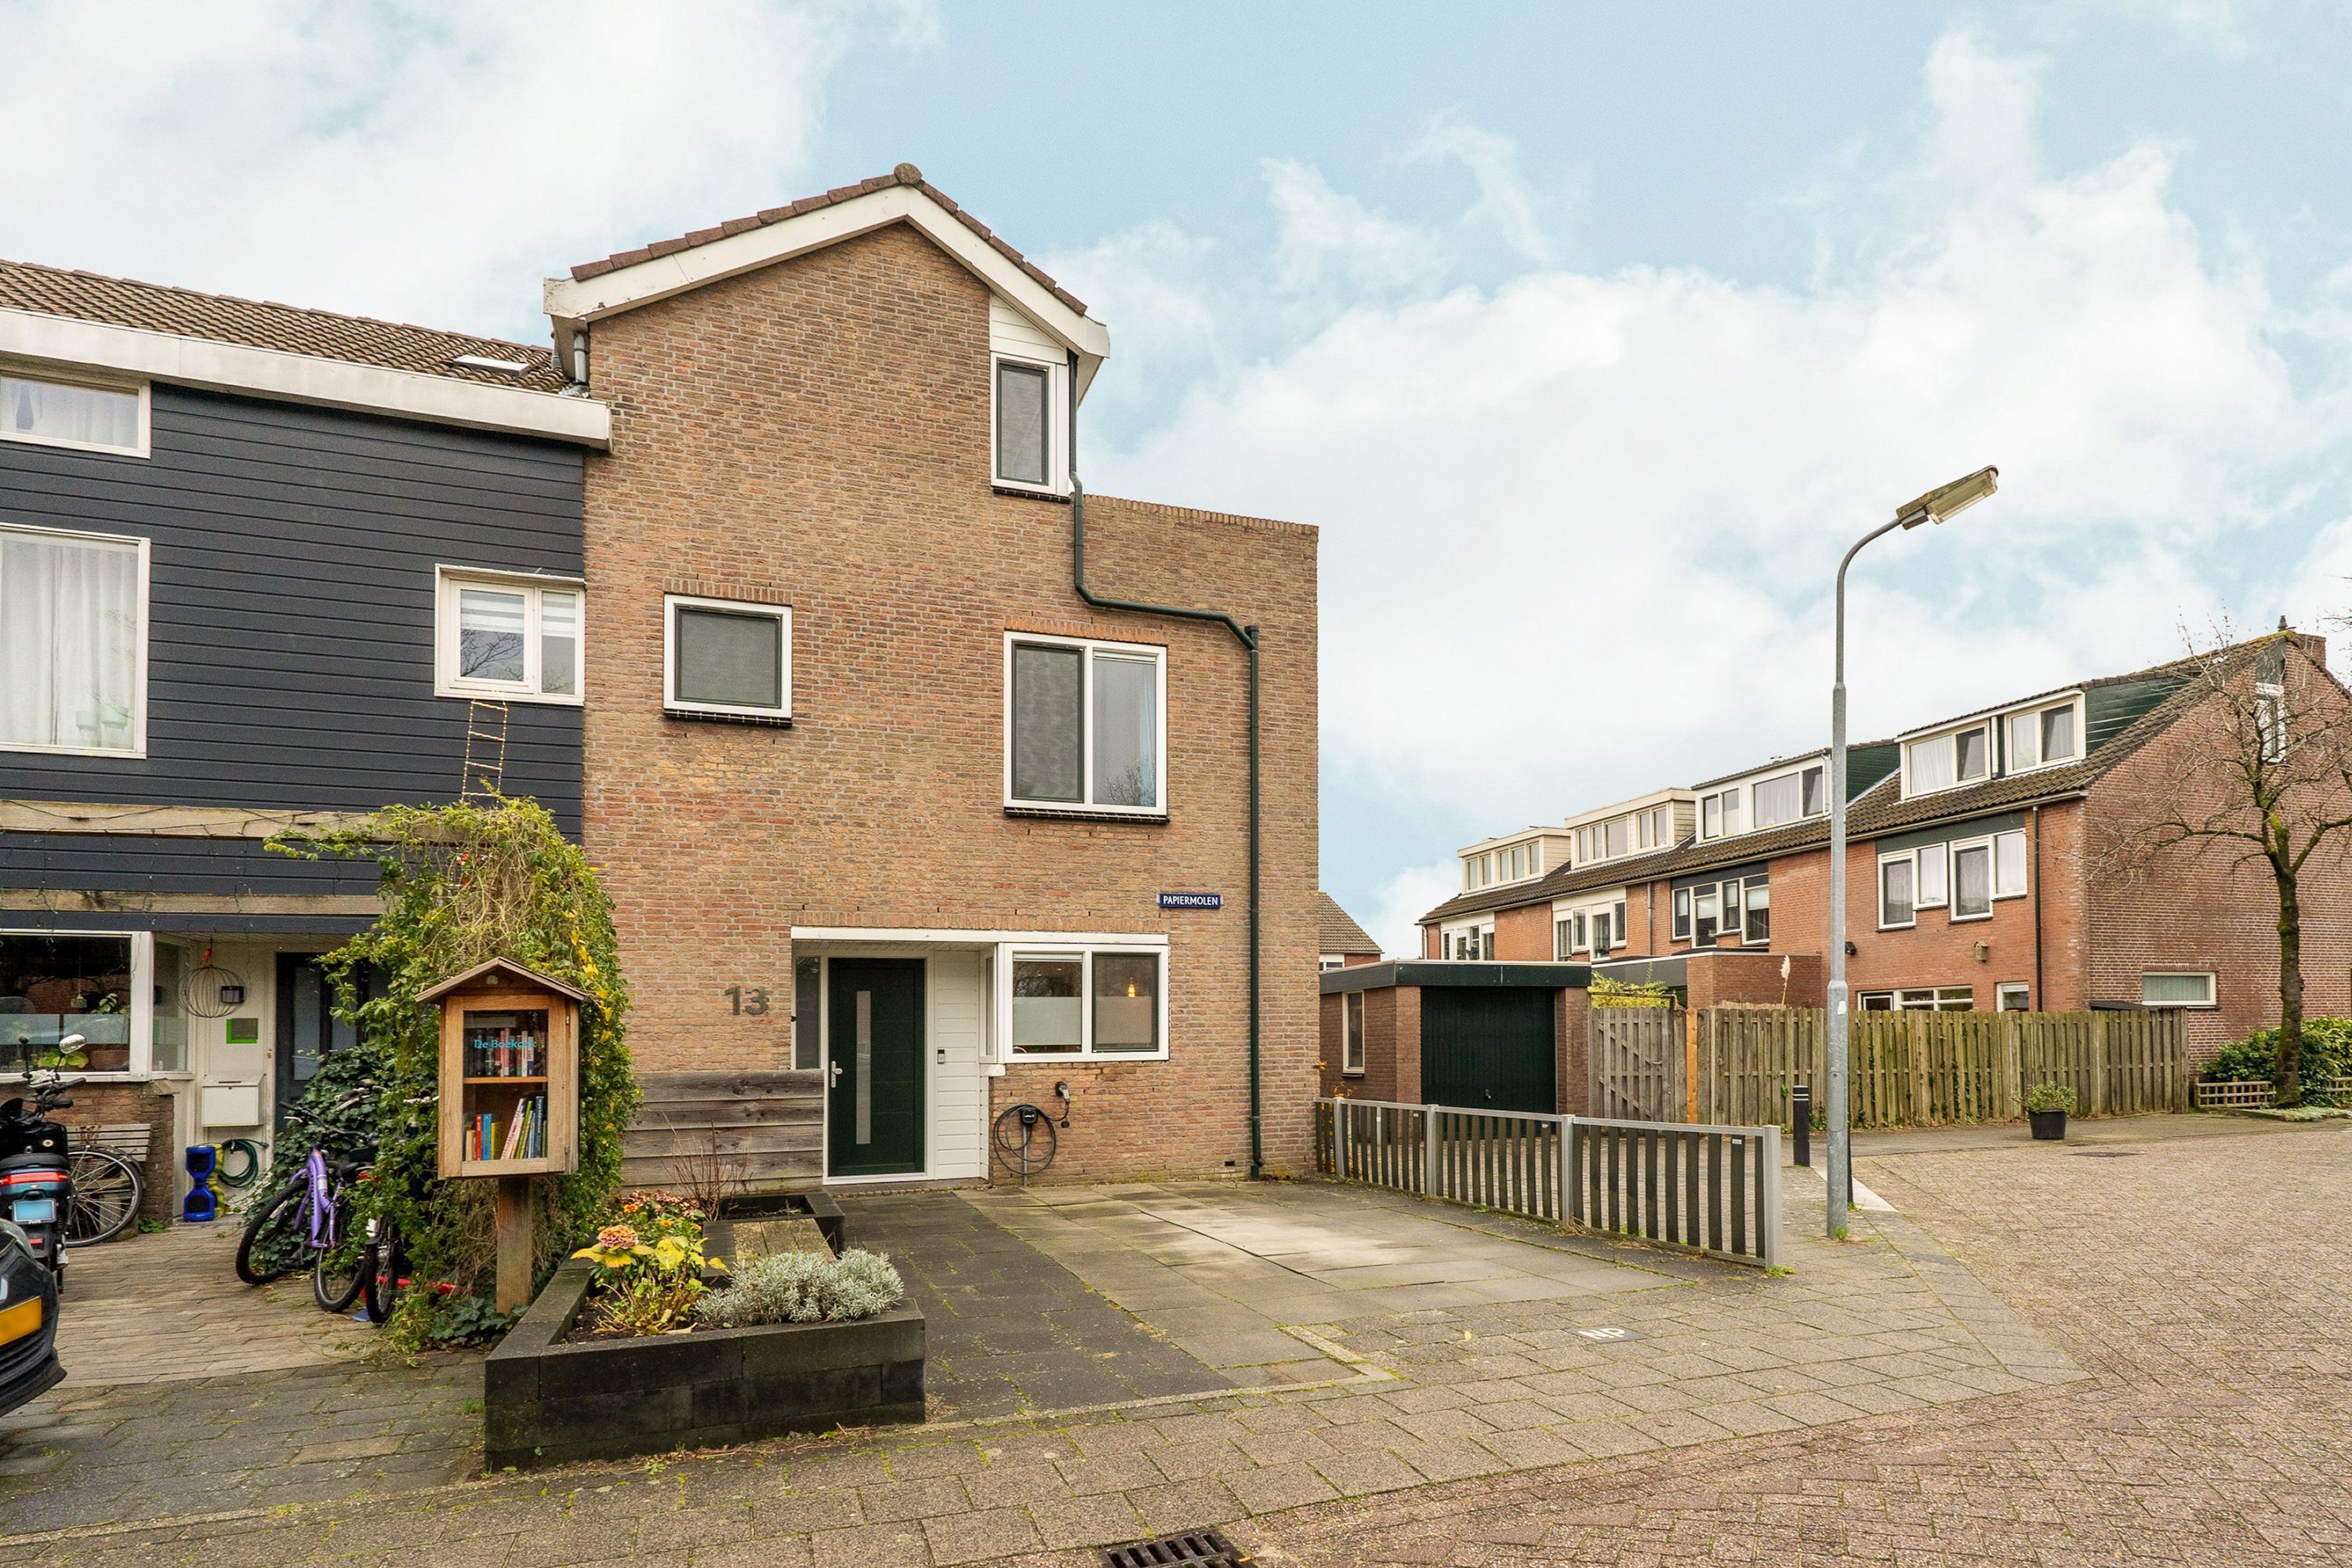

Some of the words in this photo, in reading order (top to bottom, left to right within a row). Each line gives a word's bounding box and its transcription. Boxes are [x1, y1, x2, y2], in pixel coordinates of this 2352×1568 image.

[1163, 895, 1218, 906] PAPIERMOLEN
[724, 985, 768, 1015] 13
[474, 1039, 489, 1049] De
[1577, 1327, 1625, 1340] NP
